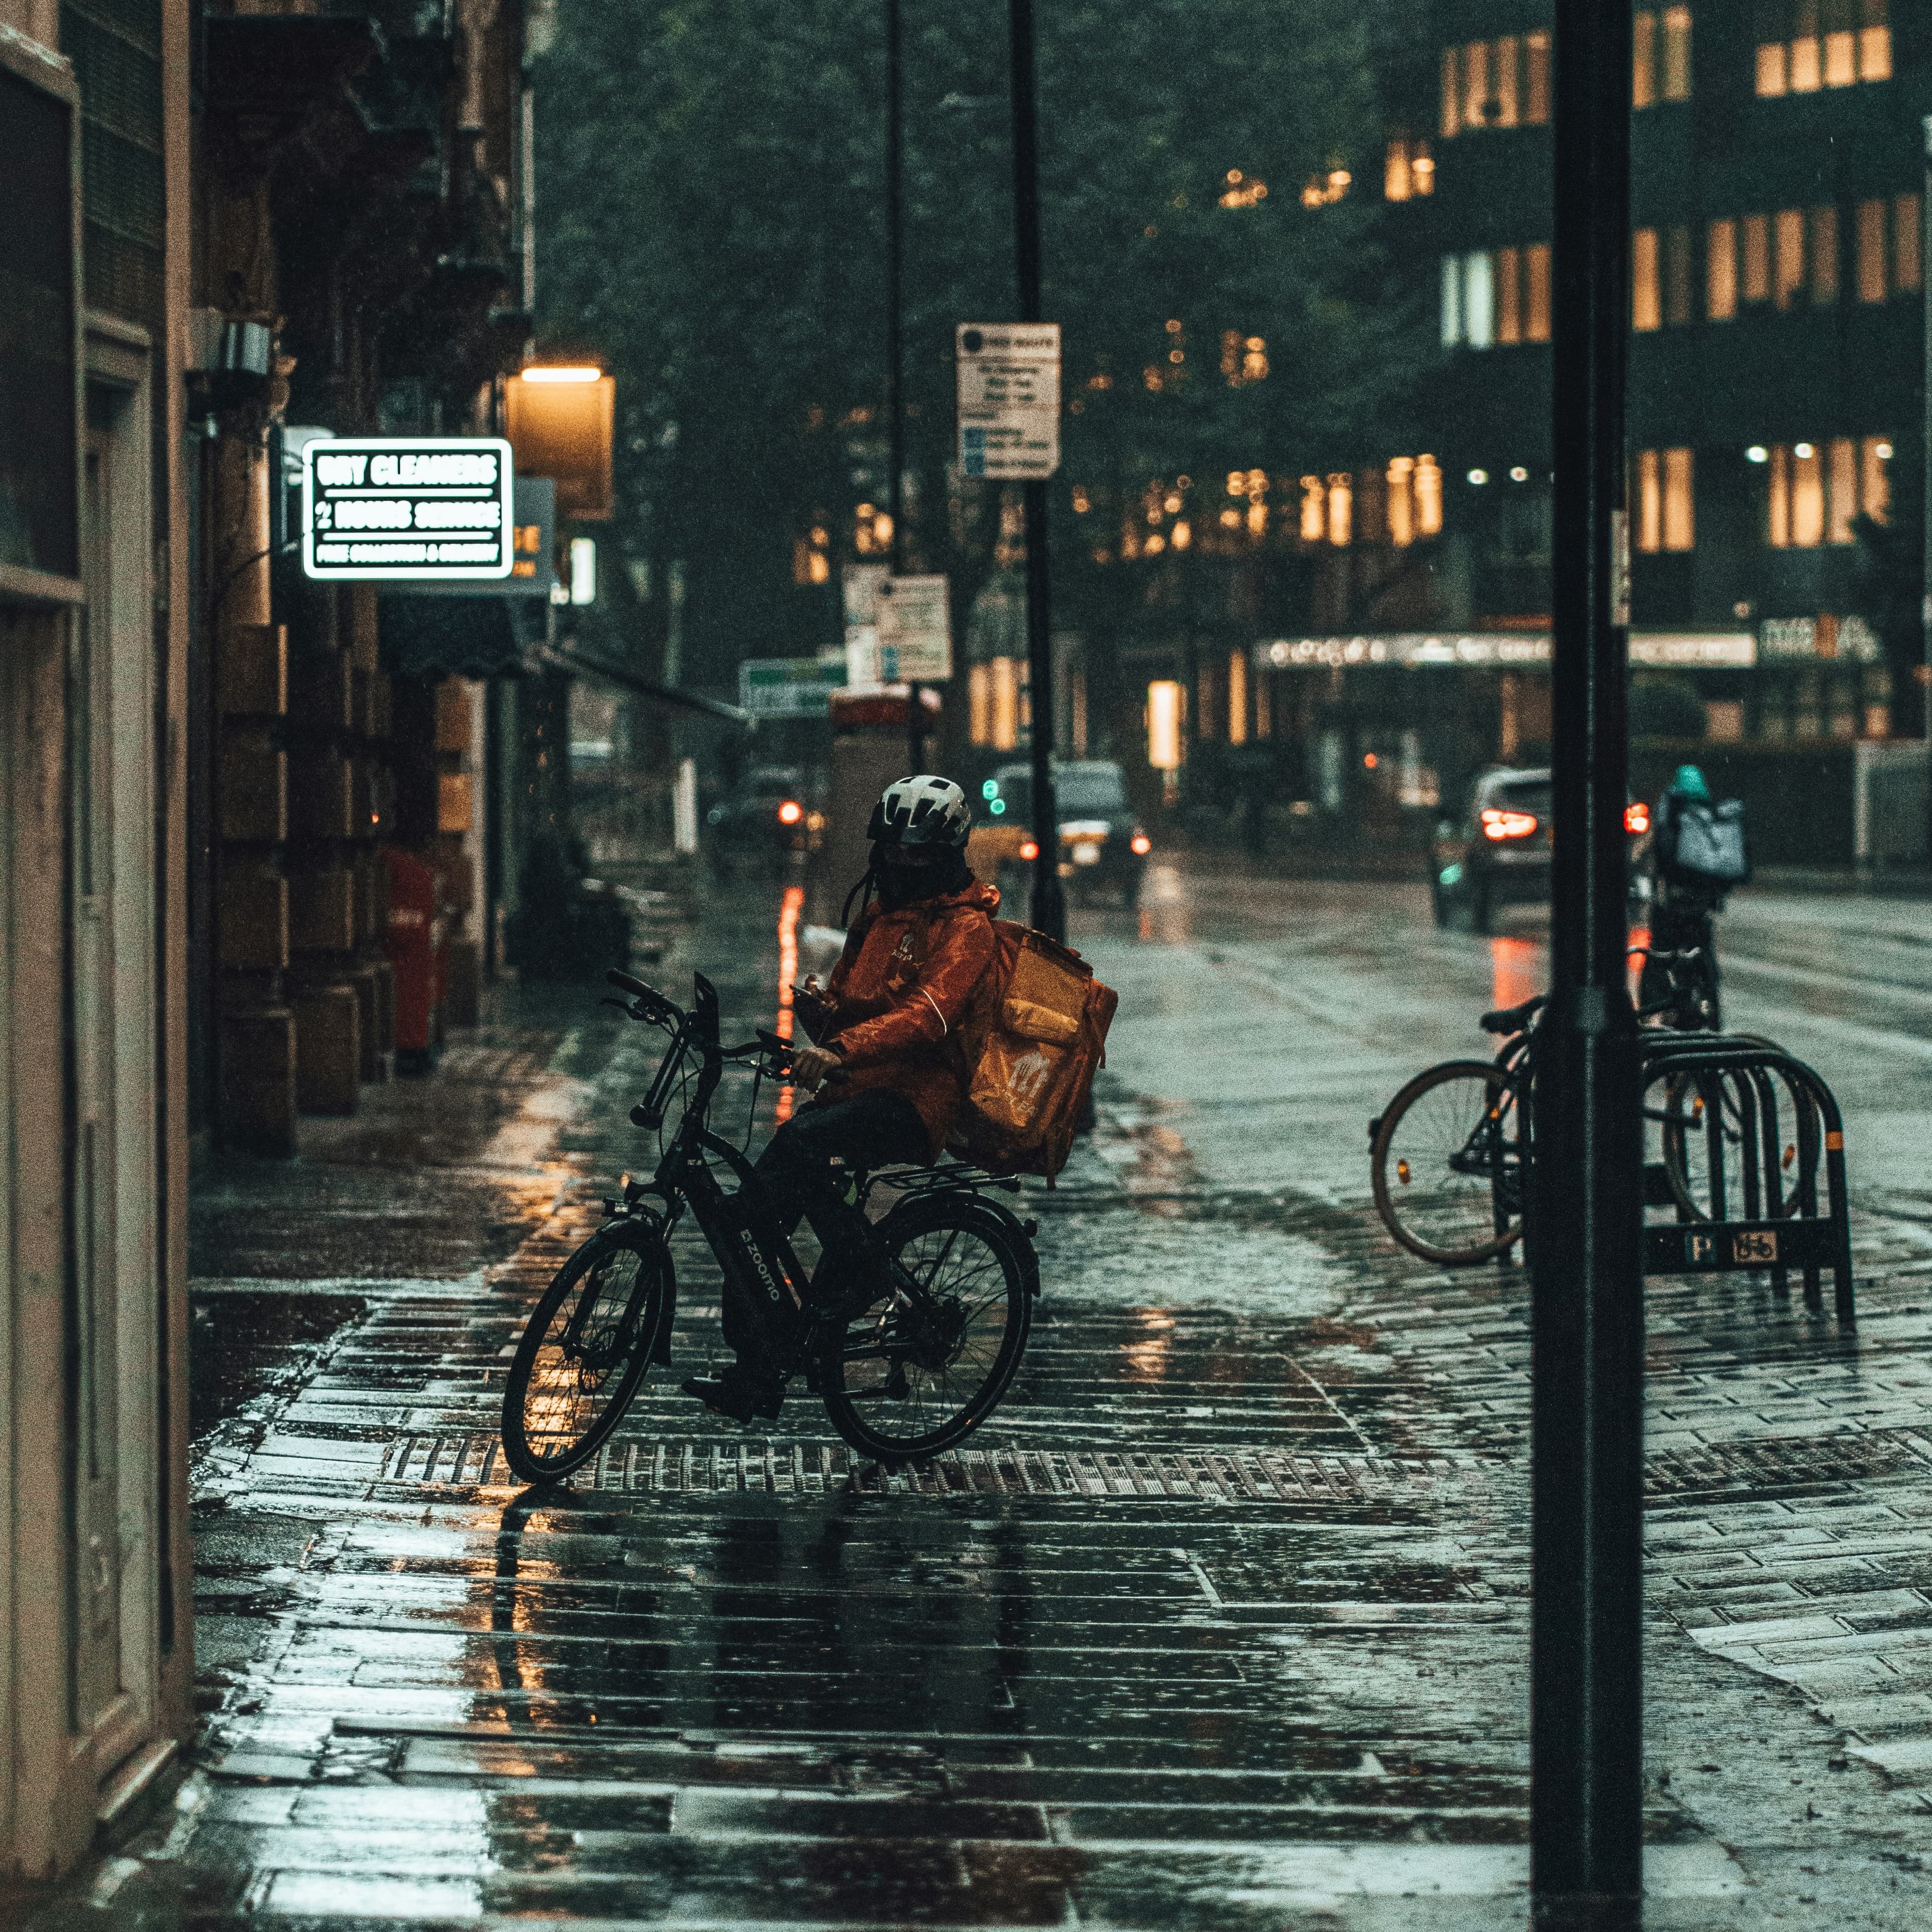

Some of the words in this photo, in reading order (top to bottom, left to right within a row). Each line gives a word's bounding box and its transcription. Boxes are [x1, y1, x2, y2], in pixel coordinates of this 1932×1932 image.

[317, 455, 368, 485] DRY
[371, 454, 497, 485] CLEANERS
[314, 501, 332, 529] 2
[1693, 1235, 1711, 1261] P
[747, 1242, 780, 1301] zoomo
